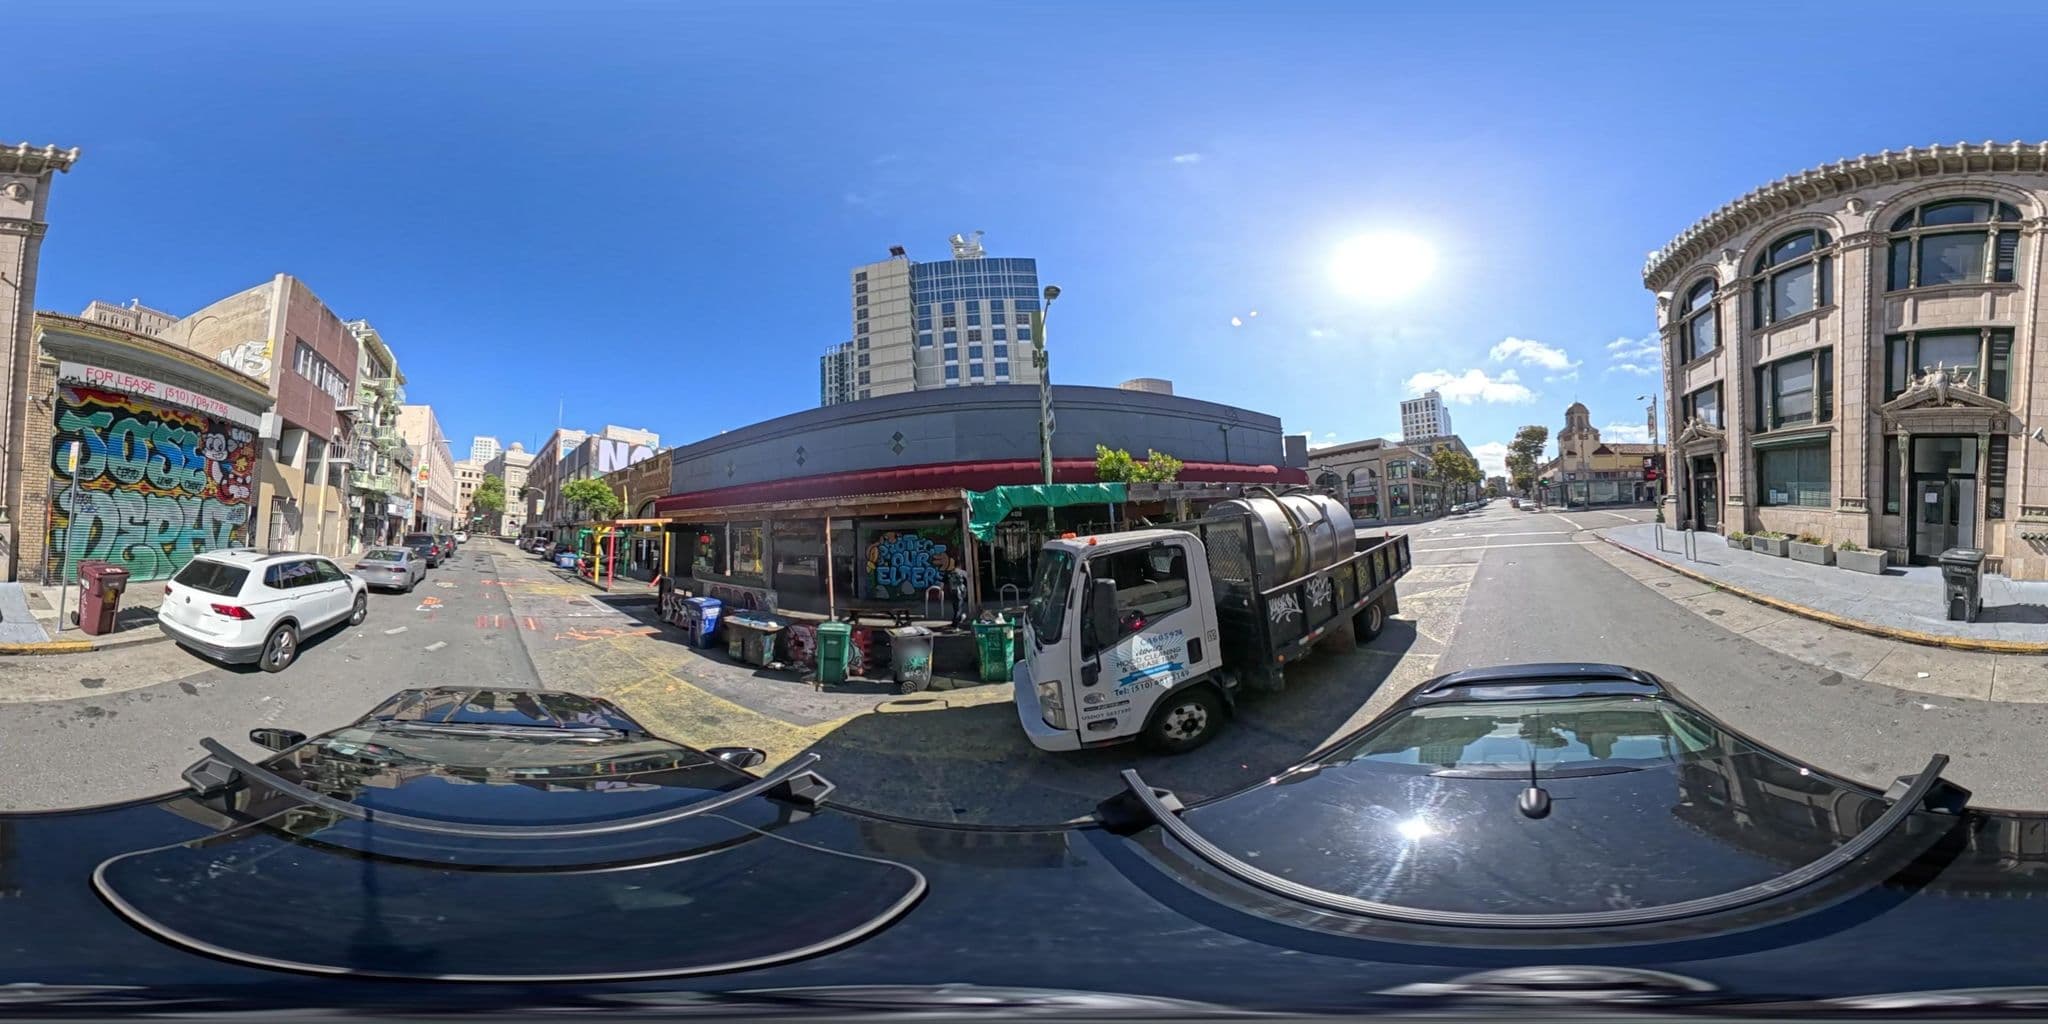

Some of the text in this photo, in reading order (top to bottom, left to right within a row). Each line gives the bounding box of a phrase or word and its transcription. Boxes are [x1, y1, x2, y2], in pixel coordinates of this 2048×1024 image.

[86, 367, 114, 383] FOR
[118, 377, 156, 393] LEASE
[165, 387, 189, 401] (510)
[55, 409, 207, 495] JOSE
[891, 551, 931, 567] OUR
[1131, 680, 1153, 693] (510)
